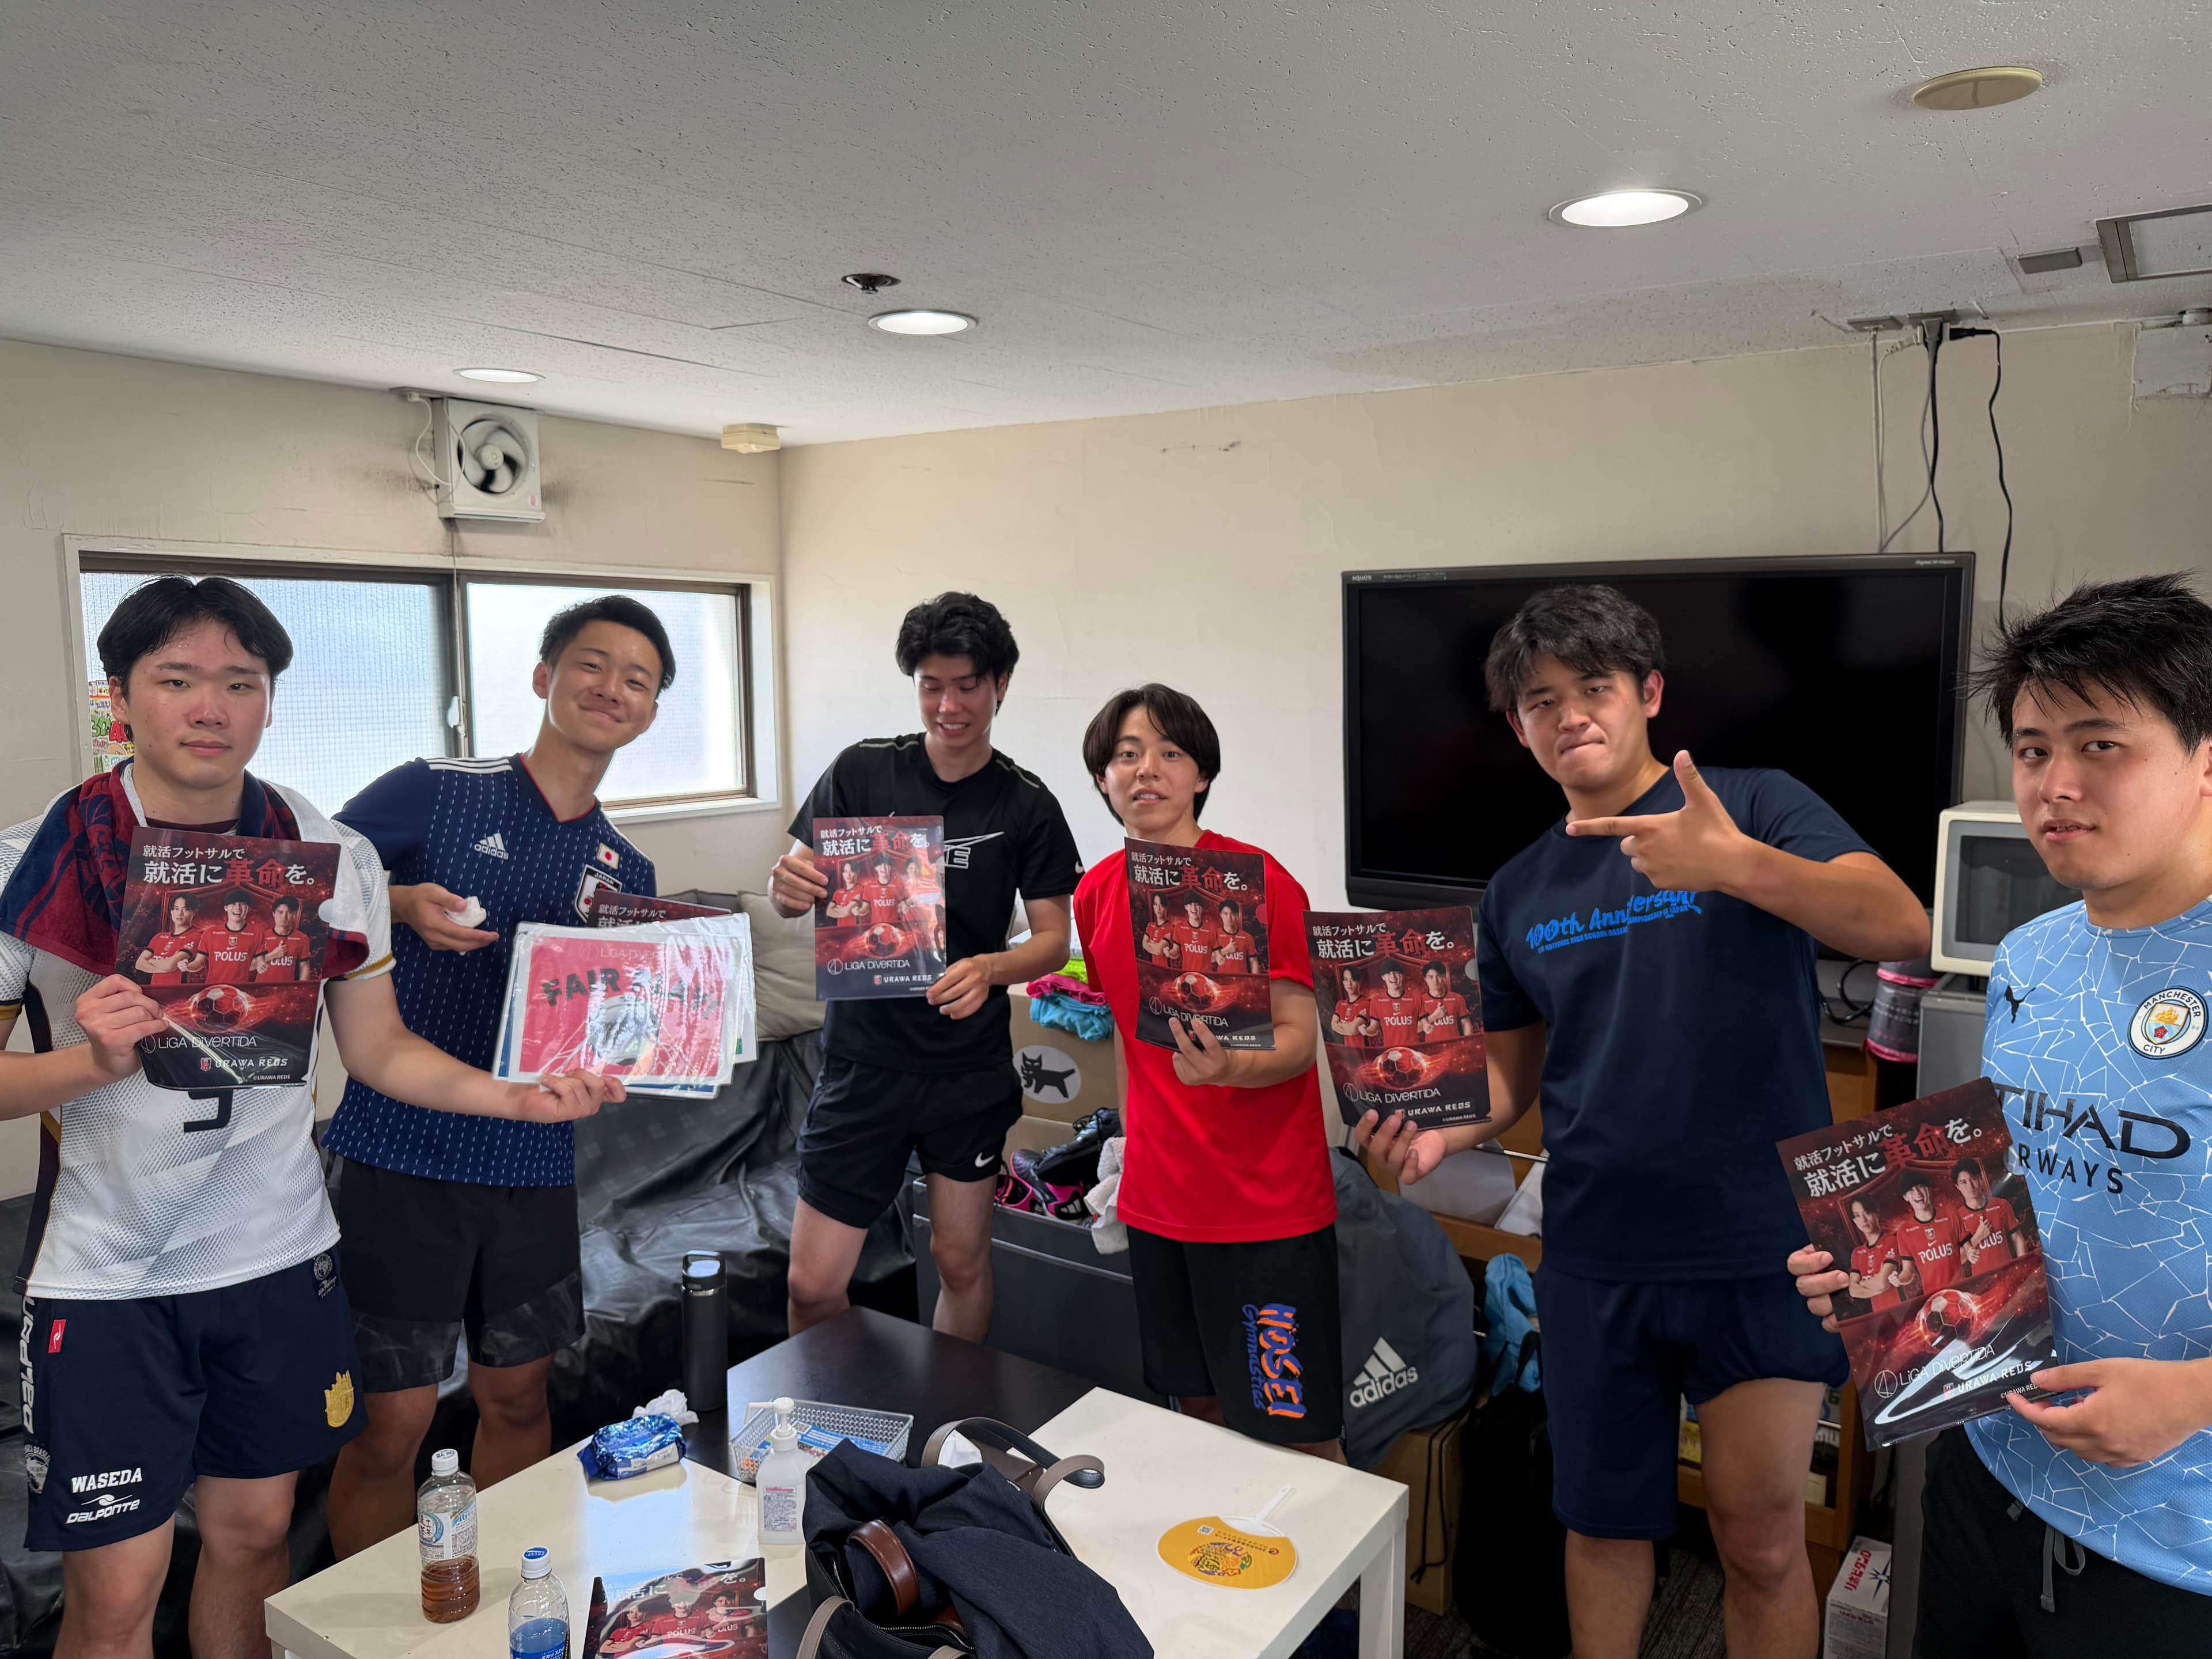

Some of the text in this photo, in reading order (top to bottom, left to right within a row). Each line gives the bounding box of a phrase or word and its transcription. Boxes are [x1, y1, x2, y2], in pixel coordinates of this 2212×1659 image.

[820, 825, 882, 839] 就活フットサルで
[474, 843, 509, 860] adidas
[823, 831, 930, 856] 就活に革命を。
[143, 844, 245, 860] 就活フットサルで
[1131, 851, 1191, 866] 就活フットサルで
[143, 858, 315, 887] 就活に革命を。
[594, 873, 614, 885] JAPAN
[1134, 863, 1248, 892] 就活に革命を。
[599, 904, 666, 918] 就活フットサルで
[874, 899, 895, 907] POLUS
[1313, 923, 1387, 937] 就活フットサルで
[1526, 912, 1584, 949] 100th
[1184, 943, 1208, 955] POLUS
[1316, 928, 1454, 959] 就活に革命を。
[214, 952, 248, 961] POLUS
[270, 956, 293, 966] OLUS
[1226, 952, 1244, 960] OLUS
[541, 968, 621, 1006] FAIR
[2143, 991, 2200, 1017] MANCHESTER
[1384, 1016, 1412, 1026] POLUS
[1434, 1014, 1455, 1025] OLUS
[2143, 1044, 2165, 1054] CITY
[215, 1058, 287, 1067] URAWA REDS
[1407, 1101, 1471, 1116] URAWA REDS
[1994, 1083, 2191, 1159] TIHAD
[1794, 1124, 1894, 1171] 就活フットサルで
[1804, 1118, 1983, 1198] 就活に革命を。
[2018, 1143, 2123, 1194] RWAYS
[1979, 1230, 2003, 1249] OLUS
[1918, 1243, 1953, 1264] POLUS
[1241, 1304, 1268, 1410] Gymnastics
[1257, 1303, 1307, 1419] HOSEI
[1958, 1360, 2032, 1393] URAWA REDS
[1350, 1366, 1419, 1407] adidas
[2026, 1384, 2039, 1392] RED
[71, 1468, 142, 1493] WASEDA
[666, 1628, 696, 1637] POLUS
[718, 1624, 738, 1633] OLUS
